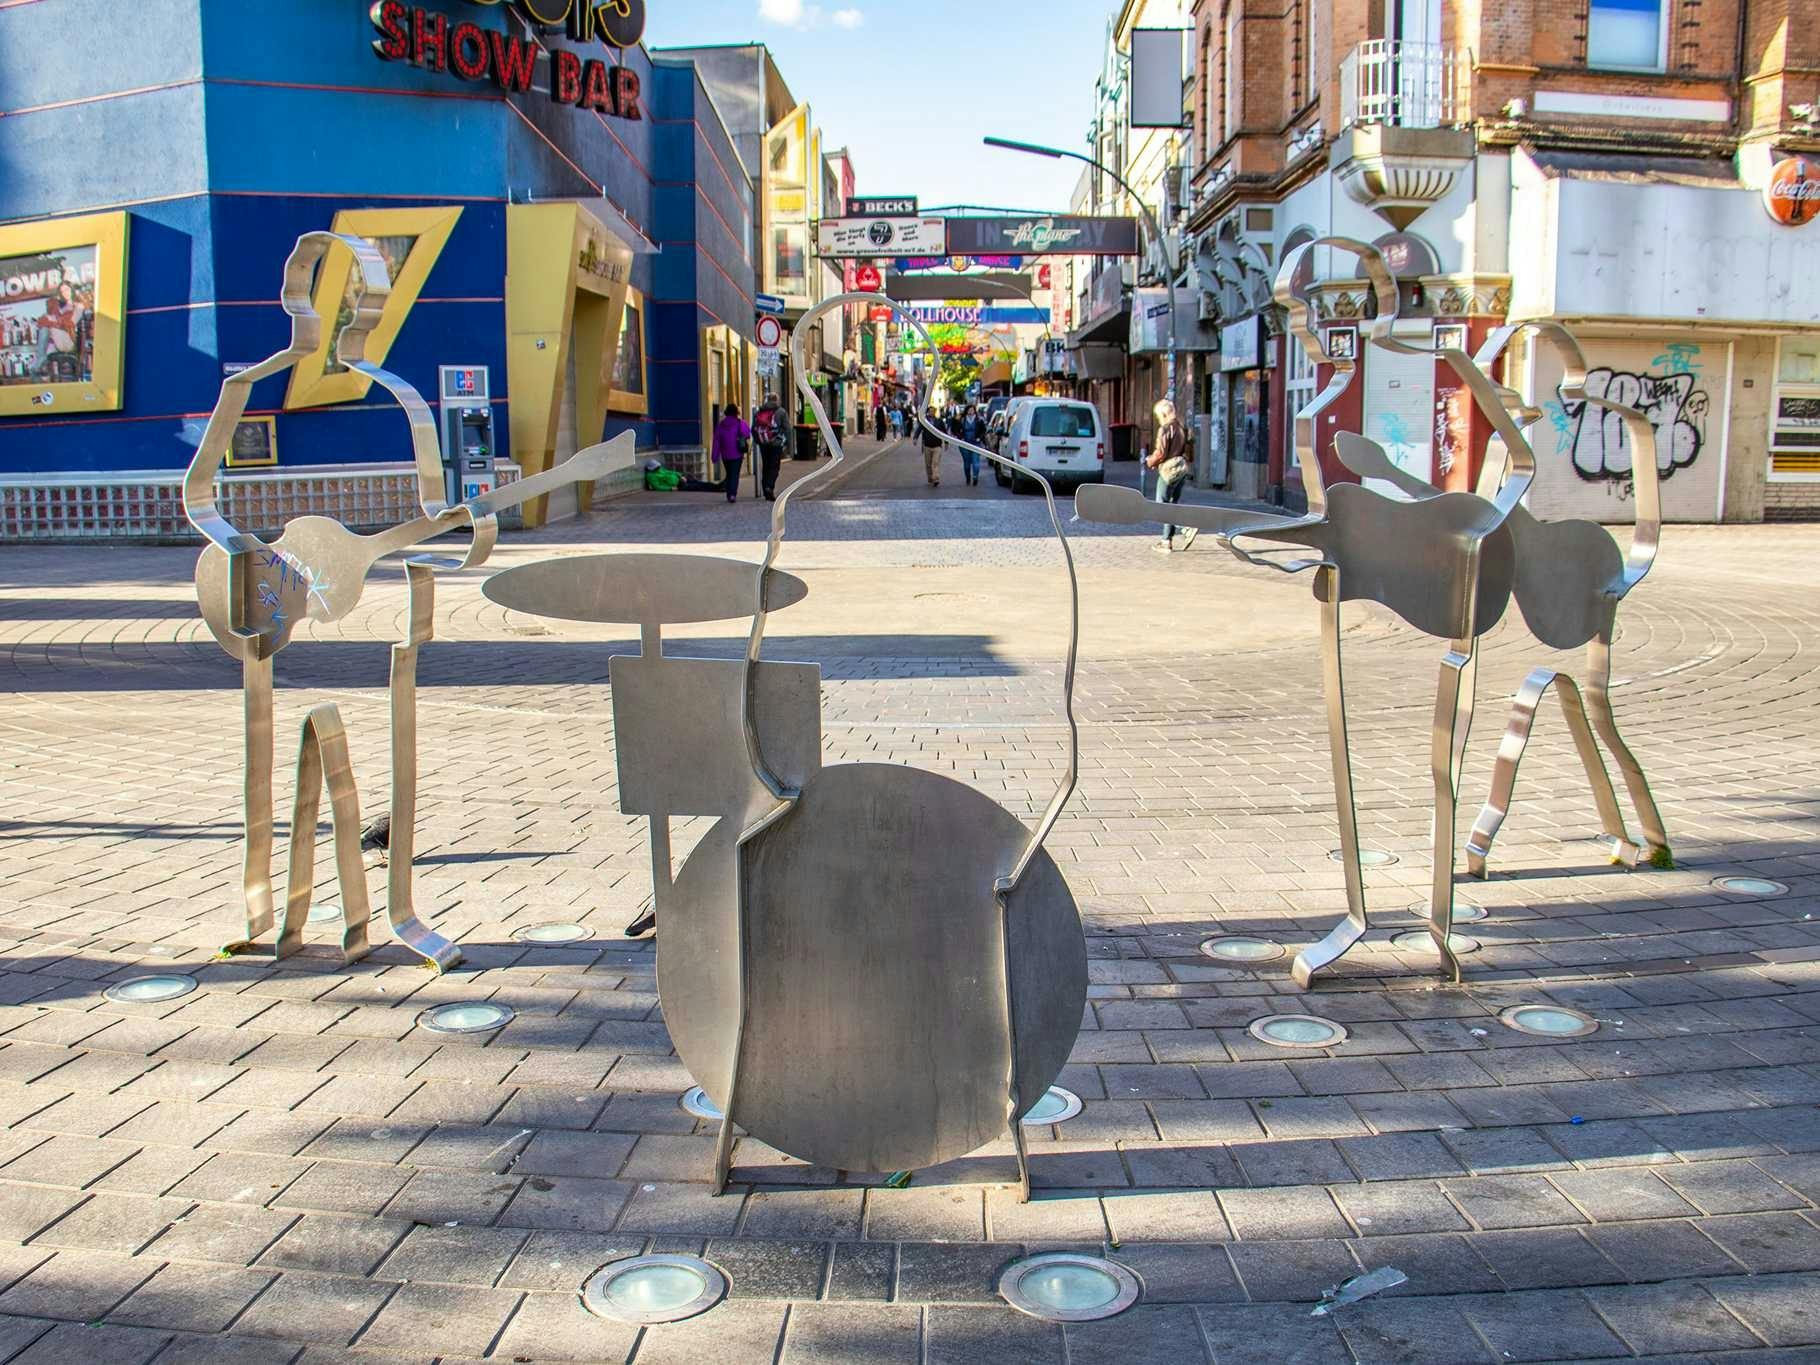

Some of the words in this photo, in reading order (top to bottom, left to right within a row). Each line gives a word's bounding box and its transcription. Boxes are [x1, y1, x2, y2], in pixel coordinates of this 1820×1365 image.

[374, 2, 537, 92] SHOW
[556, 48, 642, 120] BAR
[864, 200, 914, 213] BECK'S
